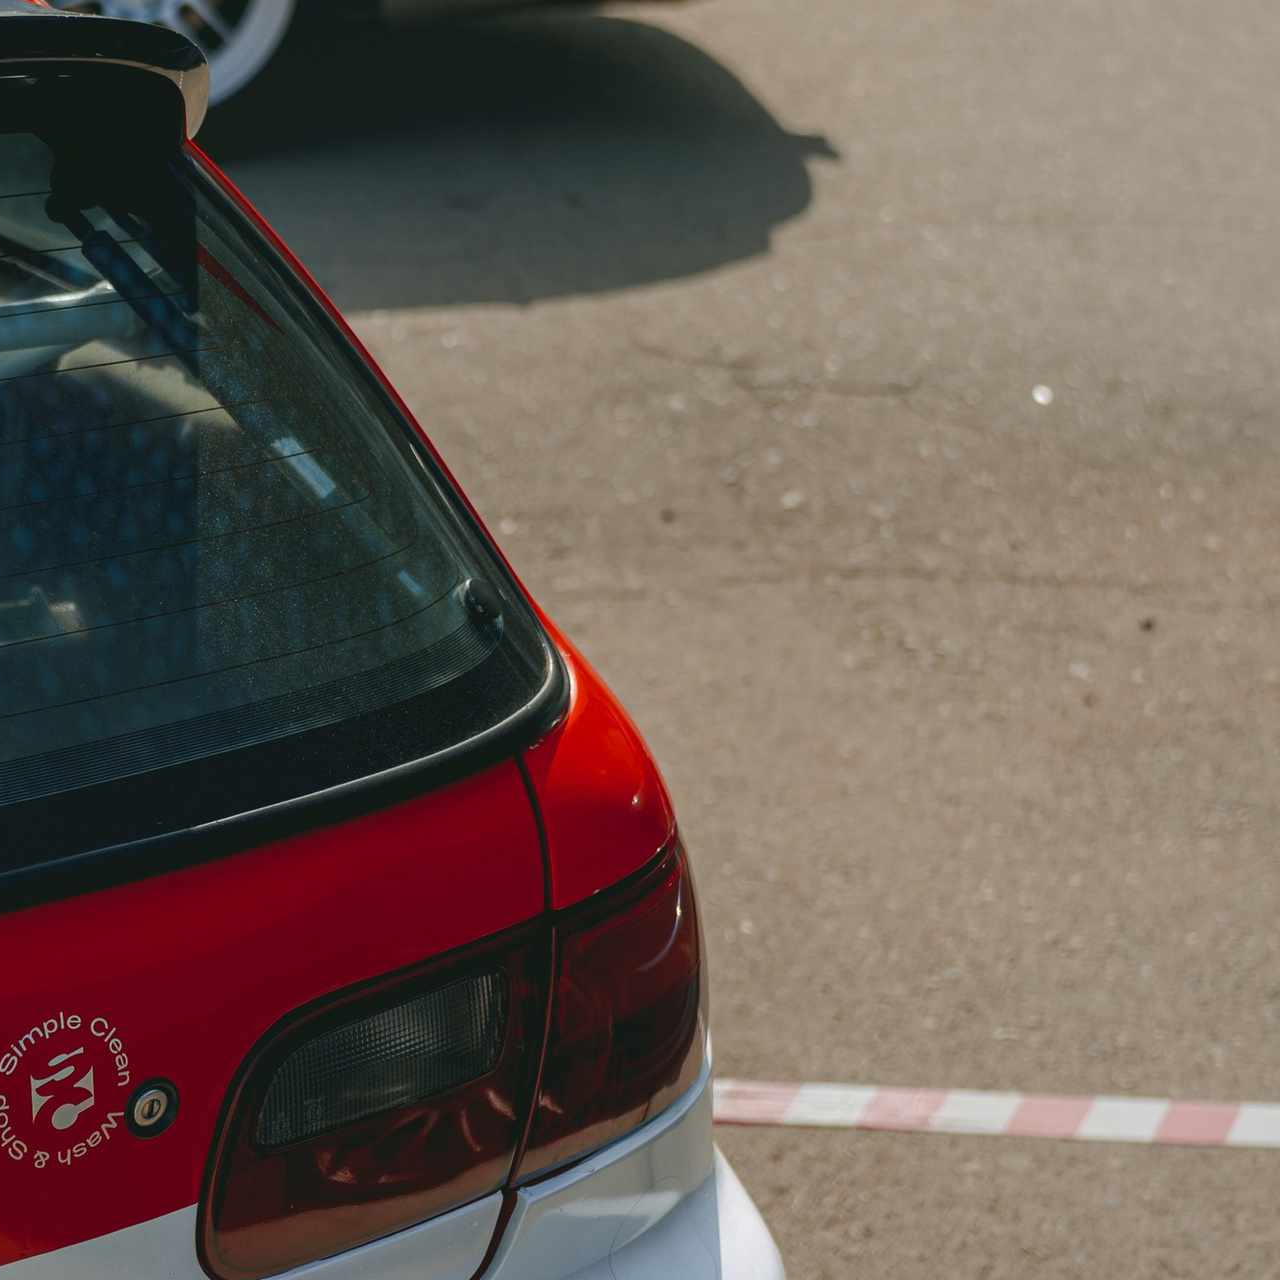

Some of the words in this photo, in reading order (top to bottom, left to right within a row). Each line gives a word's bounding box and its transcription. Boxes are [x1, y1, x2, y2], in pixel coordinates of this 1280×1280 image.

[90, 1017, 130, 1087] Clean
[33, 1150, 50, 1168] &
[57, 1111, 125, 1165] Wash
